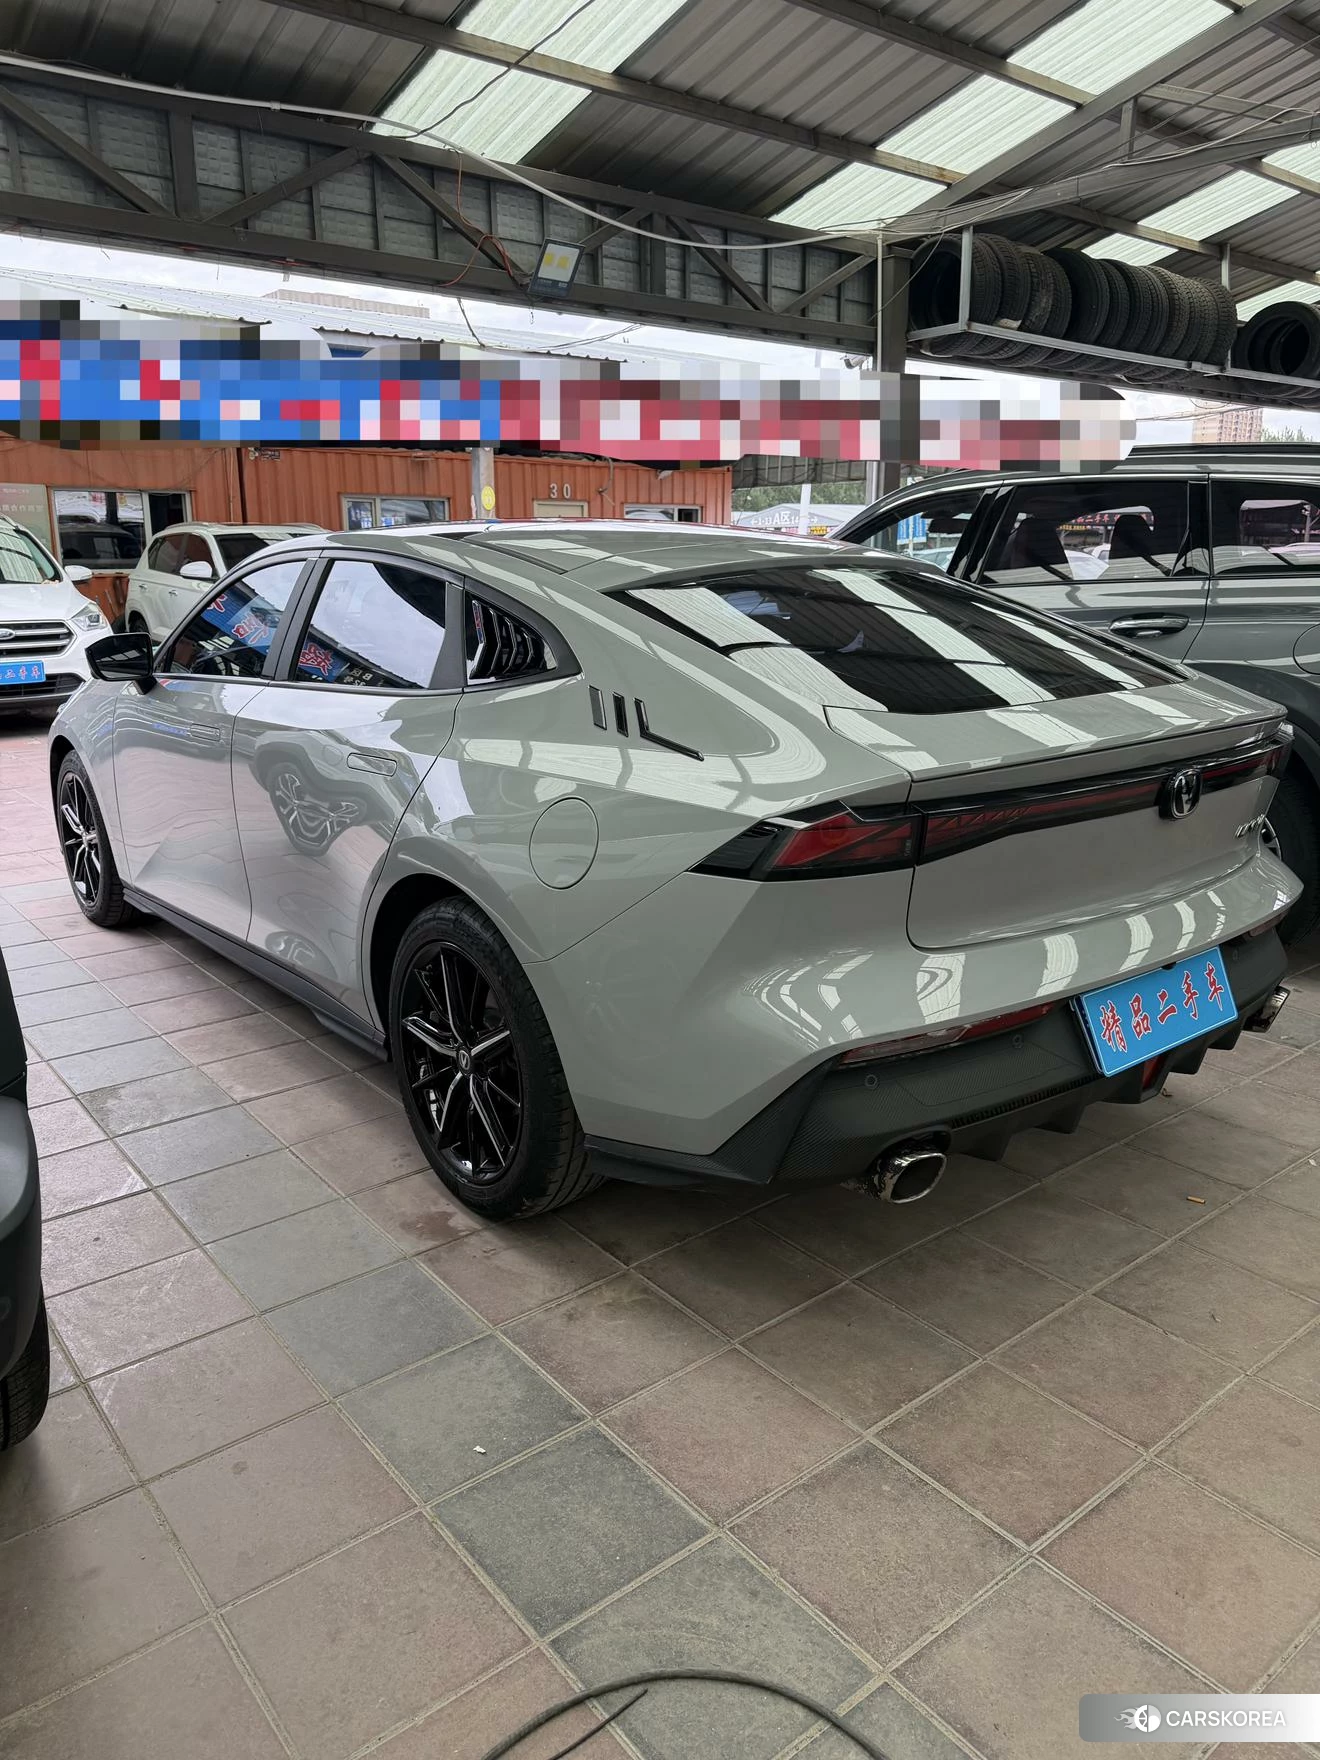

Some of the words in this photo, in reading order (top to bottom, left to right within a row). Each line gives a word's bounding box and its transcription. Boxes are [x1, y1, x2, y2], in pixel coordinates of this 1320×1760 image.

[549, 483, 571, 499] 30
[1100, 961, 1224, 1053] 精品二手车
